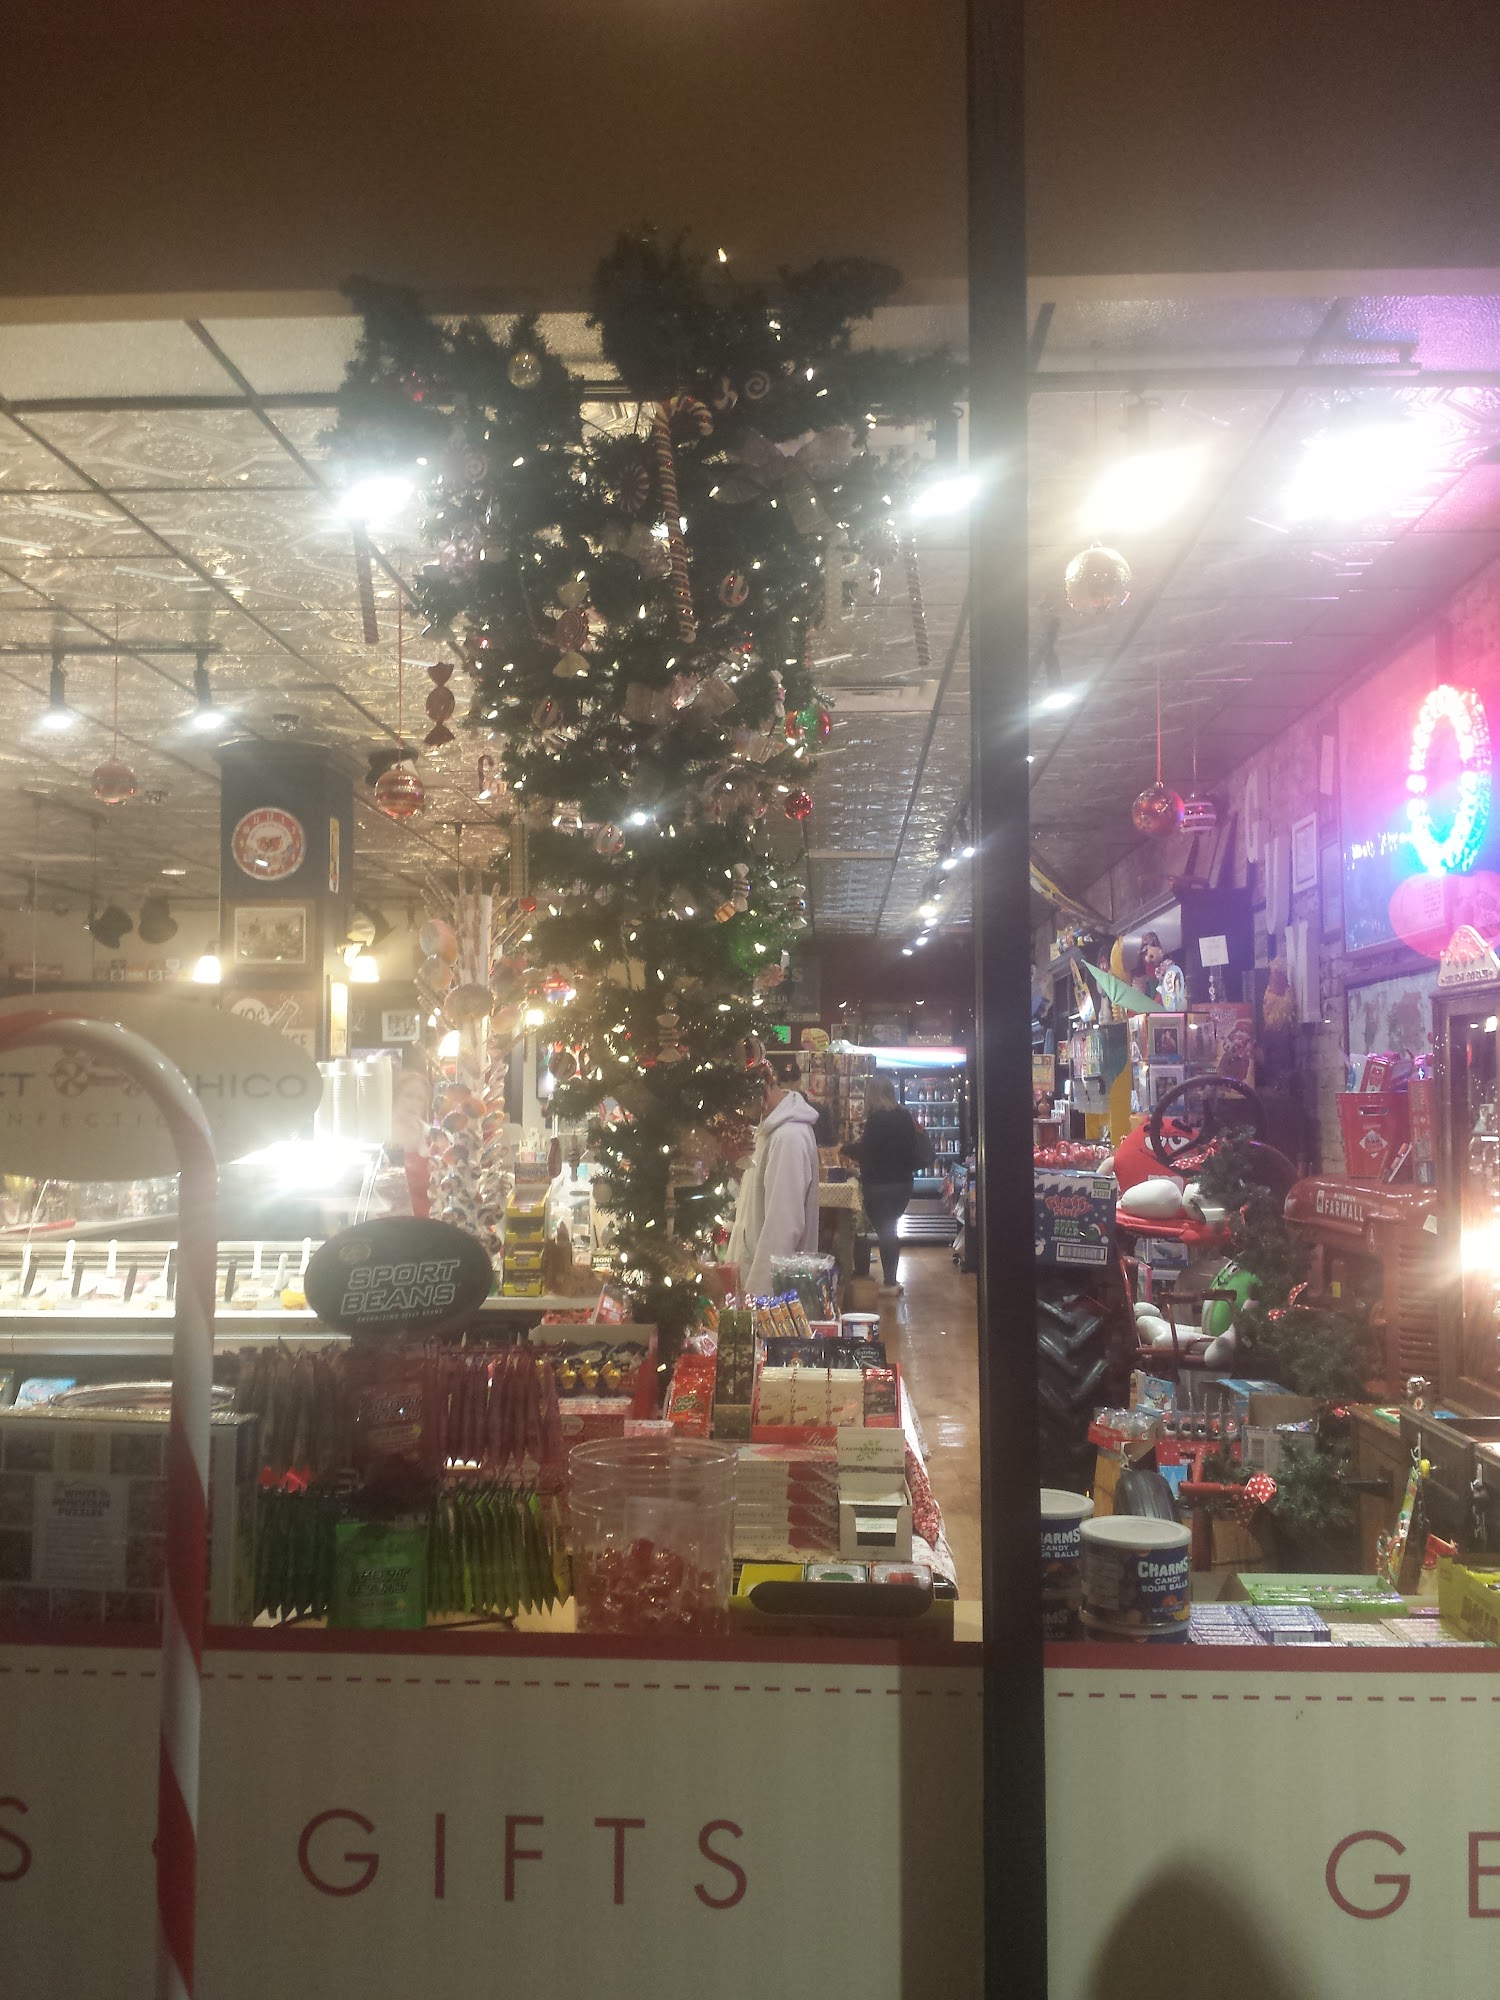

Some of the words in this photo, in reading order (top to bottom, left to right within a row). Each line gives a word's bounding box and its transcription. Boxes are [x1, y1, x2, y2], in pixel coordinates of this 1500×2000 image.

[190, 1072, 307, 1099] HICO
[1324, 1199, 1365, 1222] FARMALL
[347, 1259, 460, 1291] SPORT
[340, 1283, 456, 1316] BEANS
[1041, 1527, 1081, 1545] ARMS
[1054, 1549, 1081, 1559] BALLS
[1137, 1555, 1190, 1579] CHARMS
[1141, 1584, 1168, 1594] SOUR
[1168, 1579, 1188, 1592] BALLS
[1154, 1575, 1183, 1586] CANDY
[299, 1808, 748, 1911] GIFTS
